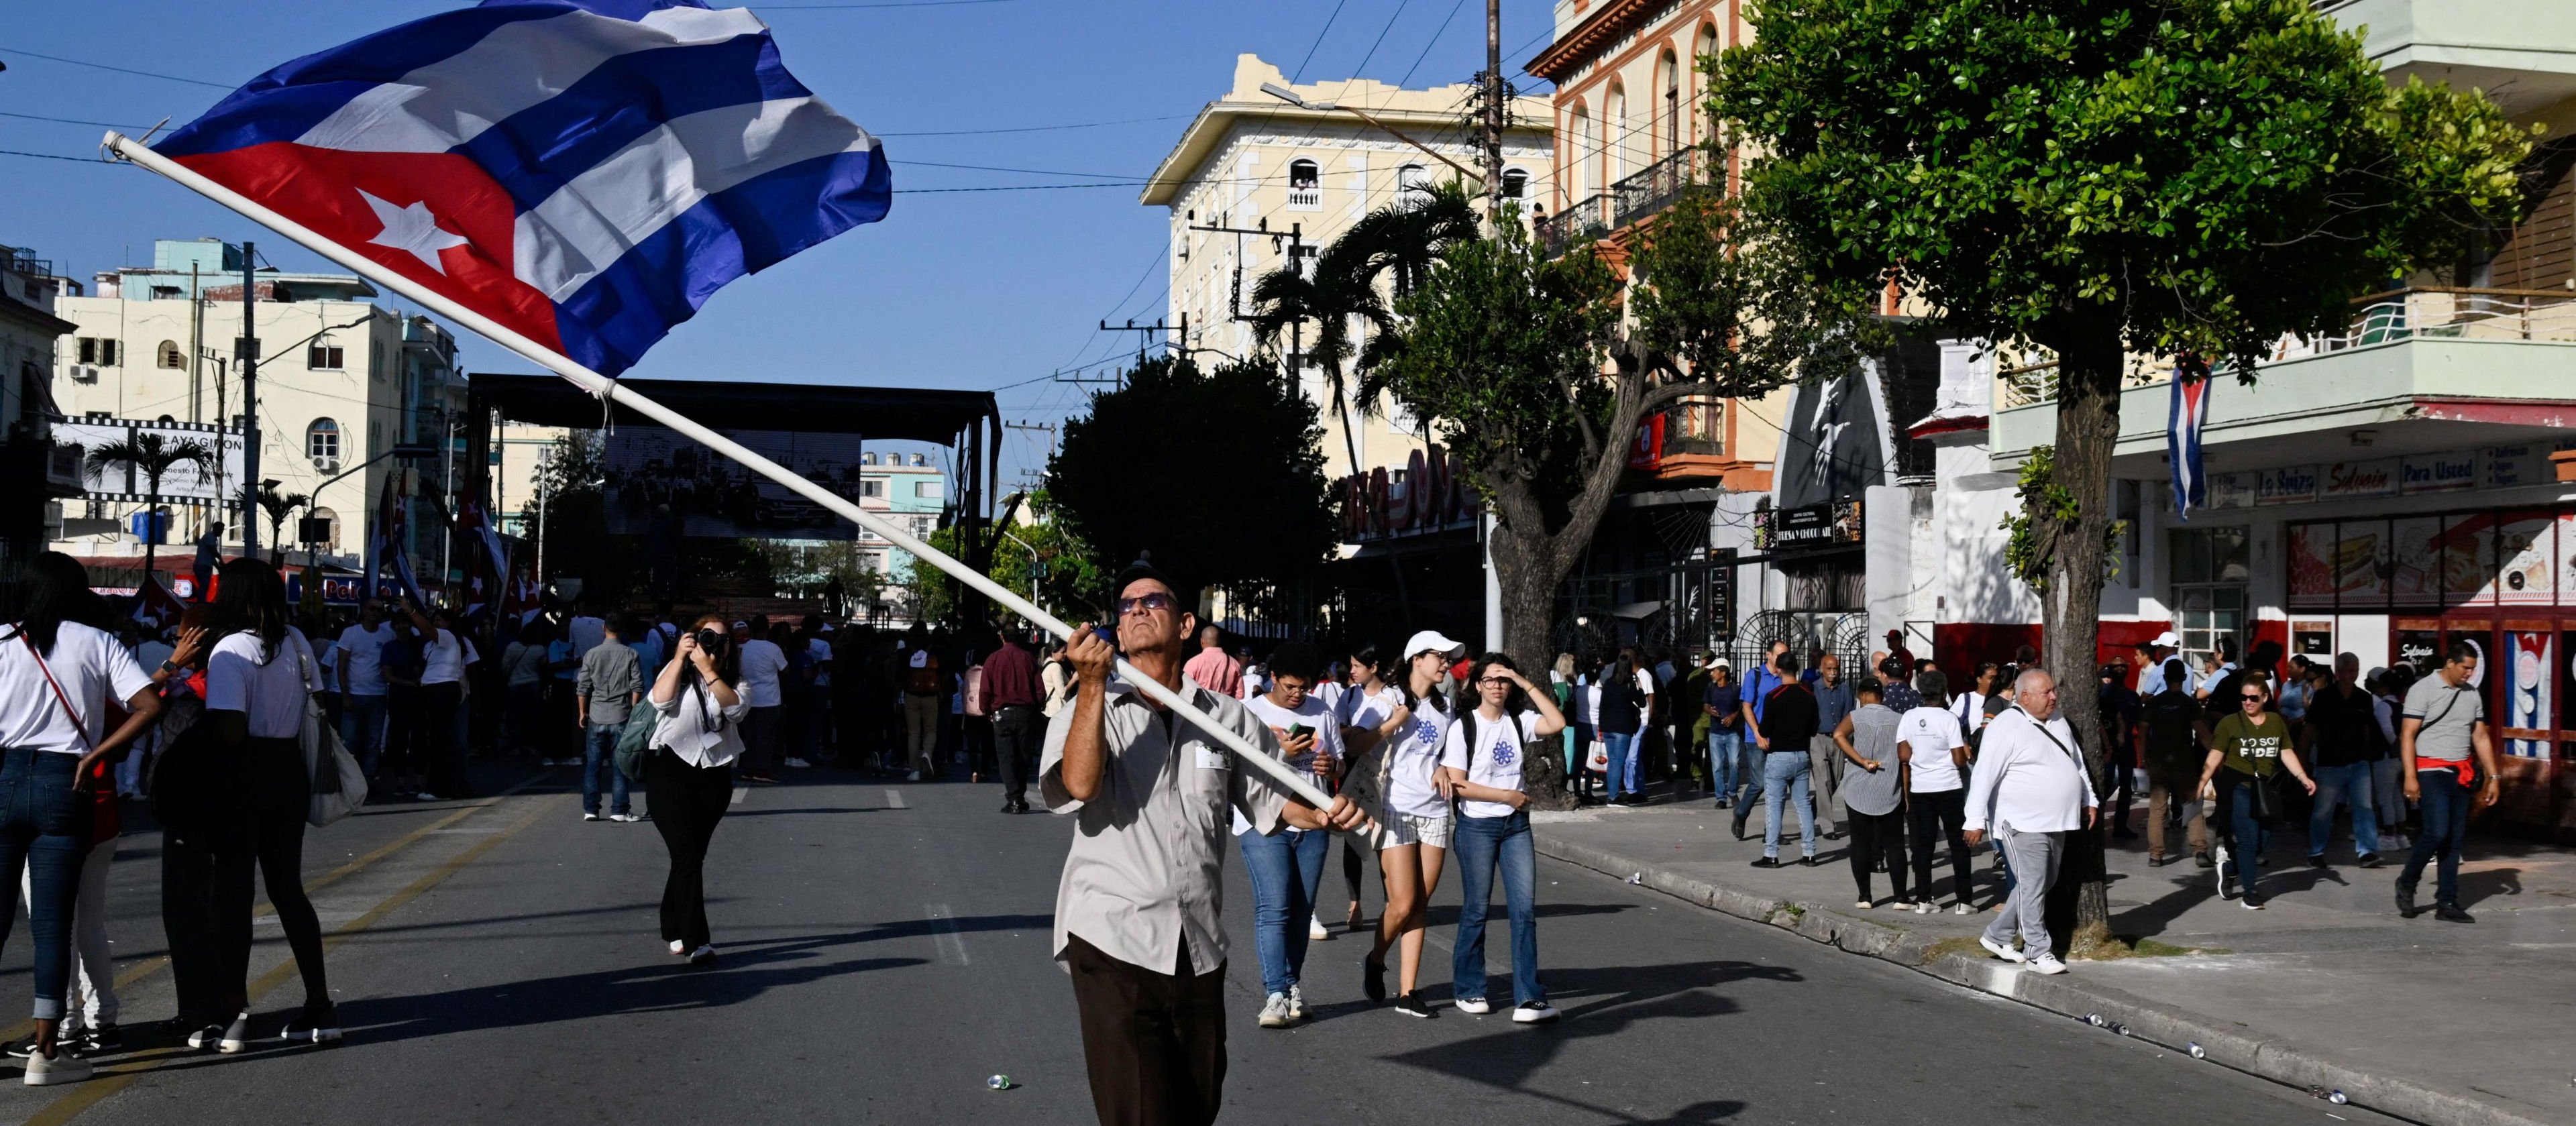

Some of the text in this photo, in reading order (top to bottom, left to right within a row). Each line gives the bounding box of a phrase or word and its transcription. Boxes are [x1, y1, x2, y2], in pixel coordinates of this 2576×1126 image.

[163, 435, 197, 447] LAYA
[2277, 469, 2314, 496] Suiza
[2328, 463, 2387, 492] Sylvain
[2404, 465, 2430, 482] Para
[2436, 459, 2473, 480] Usted
[1778, 530, 1795, 541] FRESA
[2400, 643, 2434, 660] Sylvain
[2259, 737, 2279, 747] SOY
[1289, 757, 1315, 767] uieres
